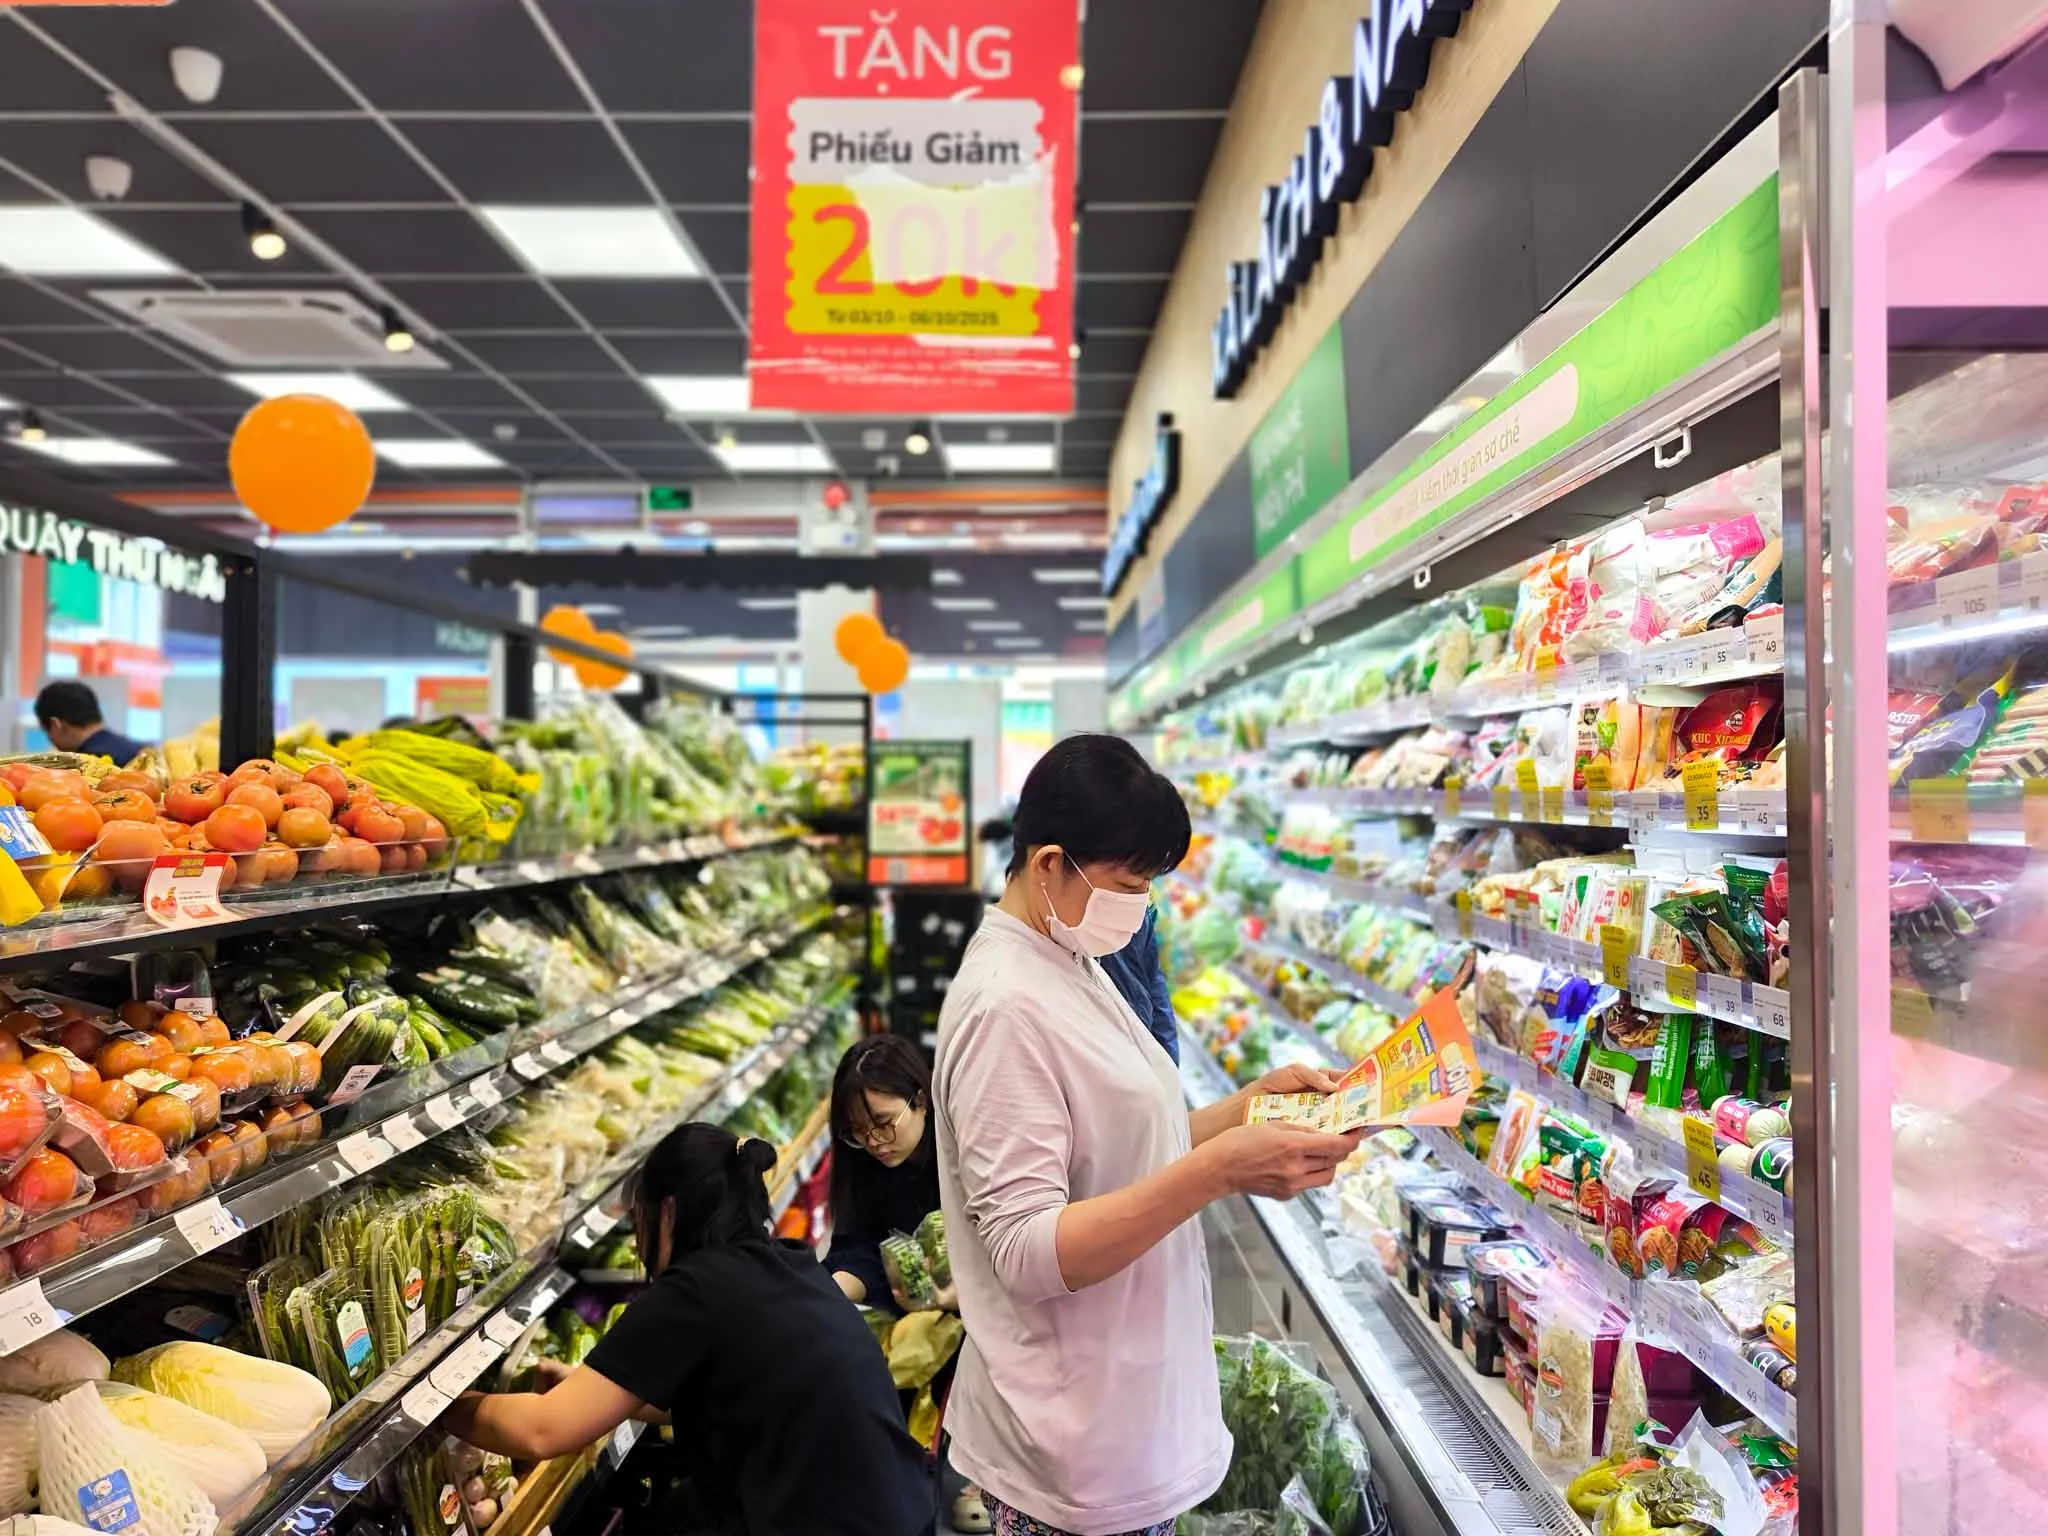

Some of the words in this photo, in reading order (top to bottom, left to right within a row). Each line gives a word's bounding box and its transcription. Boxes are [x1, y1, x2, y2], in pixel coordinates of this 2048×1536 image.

[817, 9, 1012, 93] TẶNG
[809, 128, 912, 165] Phiếu
[925, 130, 1020, 165] Giảm
[813, 202, 1017, 298] 20k
[1766, 640, 1777, 653] 49
[1772, 1012, 1785, 1027] 68
[1698, 1170, 1712, 1189] 45
[1762, 1207, 1776, 1225] 129
[22, 1311, 43, 1329] 18
